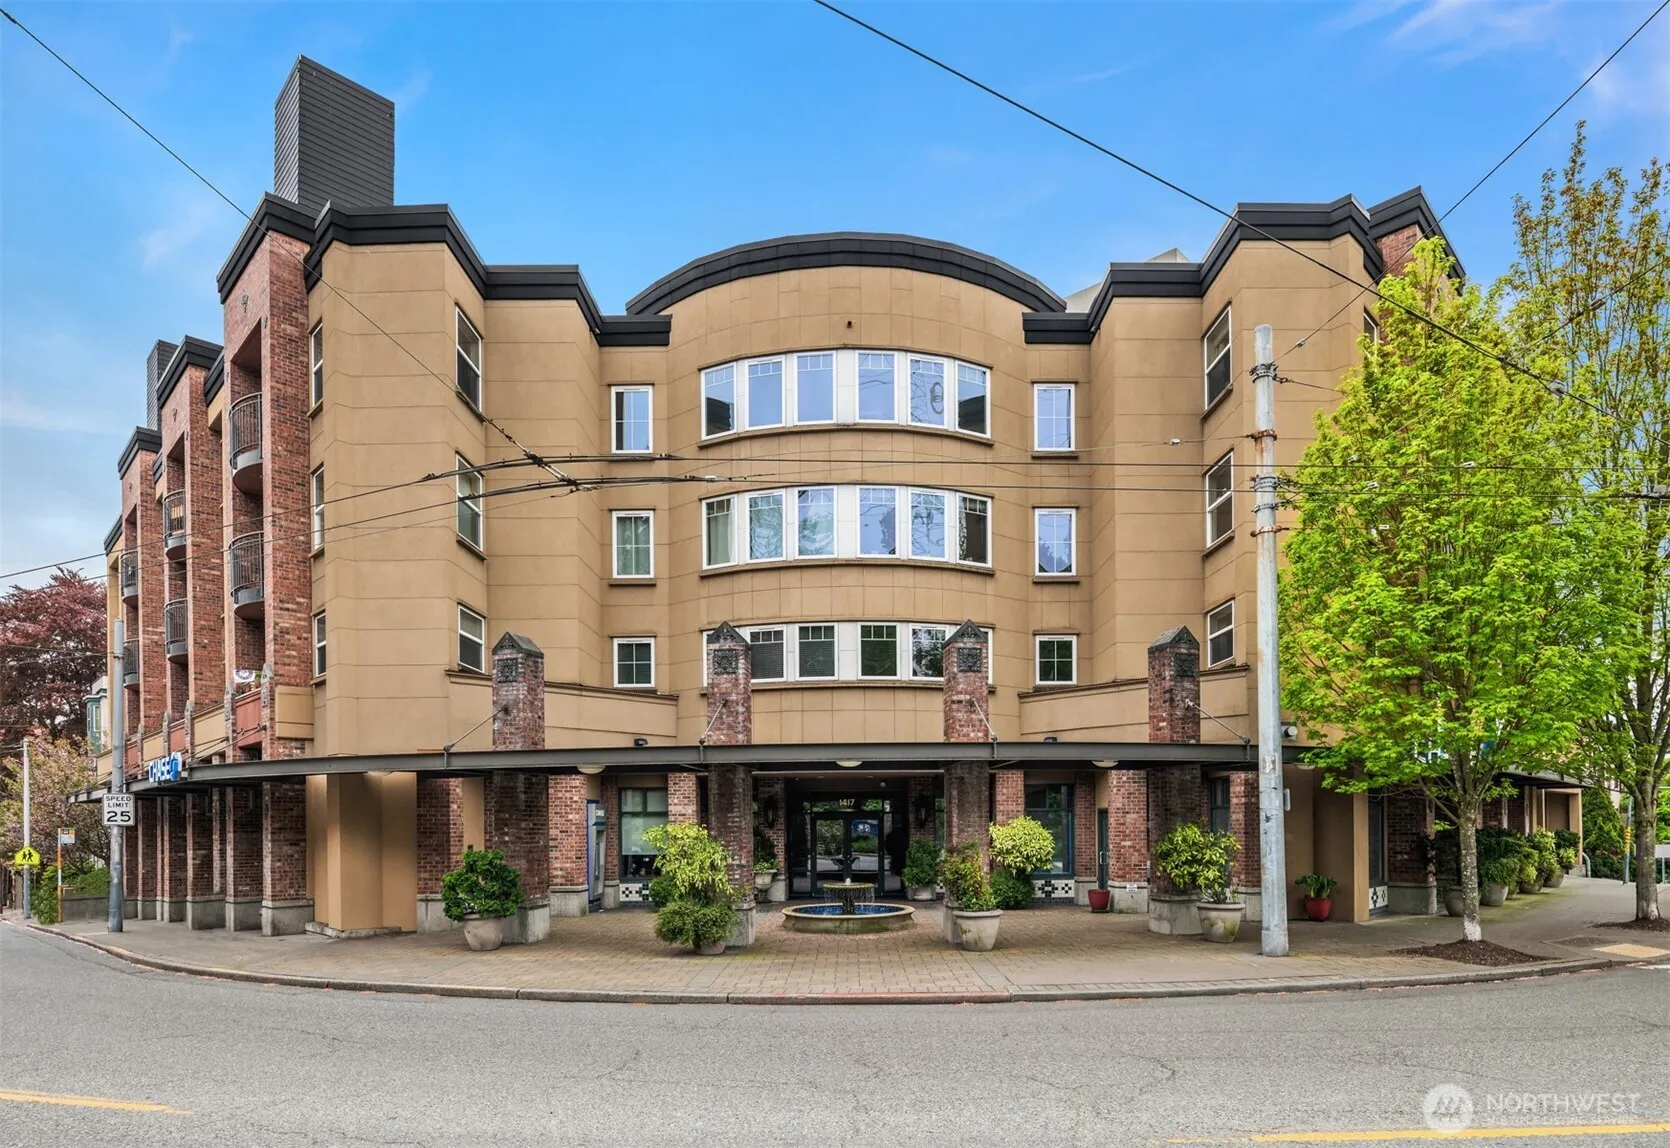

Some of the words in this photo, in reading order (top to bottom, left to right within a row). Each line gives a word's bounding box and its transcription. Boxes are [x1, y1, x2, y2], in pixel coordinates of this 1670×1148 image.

[149, 757, 171, 782] CHASE
[839, 798, 856, 806] 1417
[106, 811, 131, 822] 25
